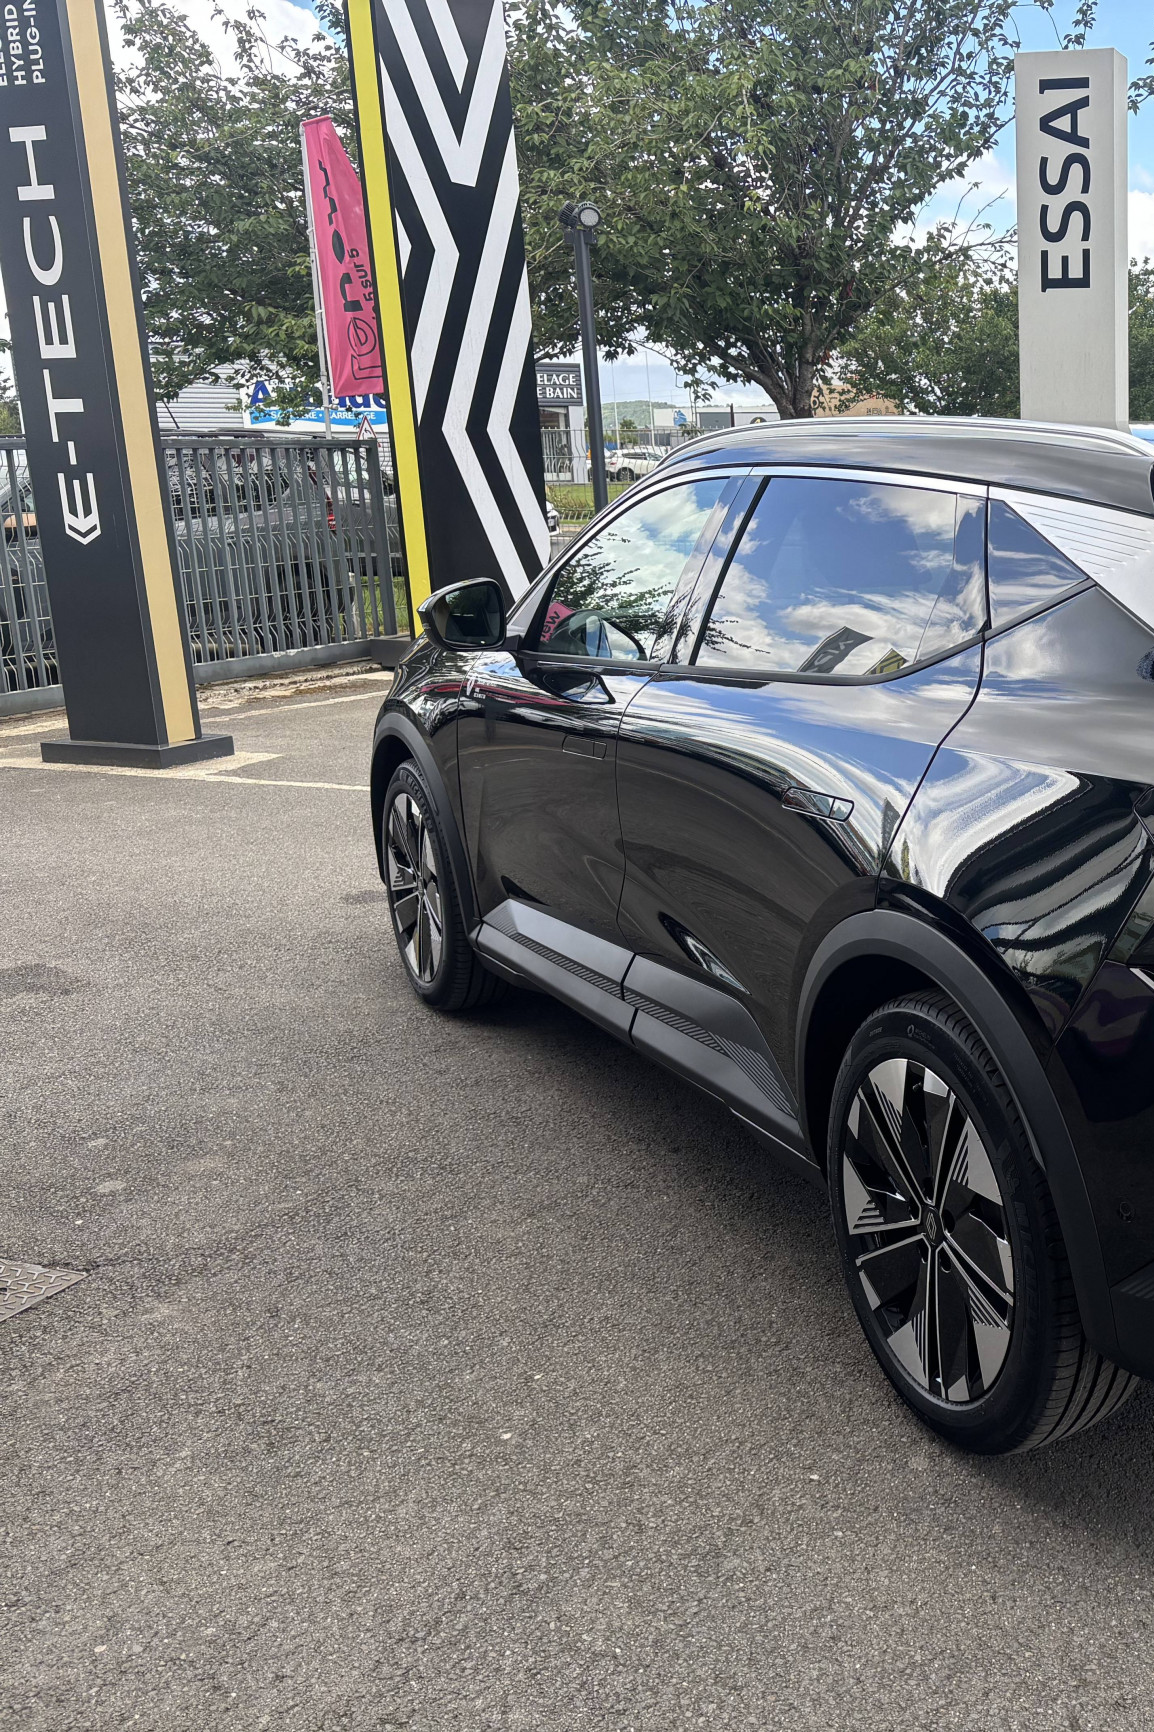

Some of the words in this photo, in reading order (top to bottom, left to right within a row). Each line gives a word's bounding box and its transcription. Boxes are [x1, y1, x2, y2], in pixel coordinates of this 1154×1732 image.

[4, 4, 27, 85] HYBRID
[1038, 76, 1092, 293] ESSAI
[353, 261, 373, 289] sur
[8, 124, 102, 546] E-TECH
[545, 387, 577, 399] BAIN
